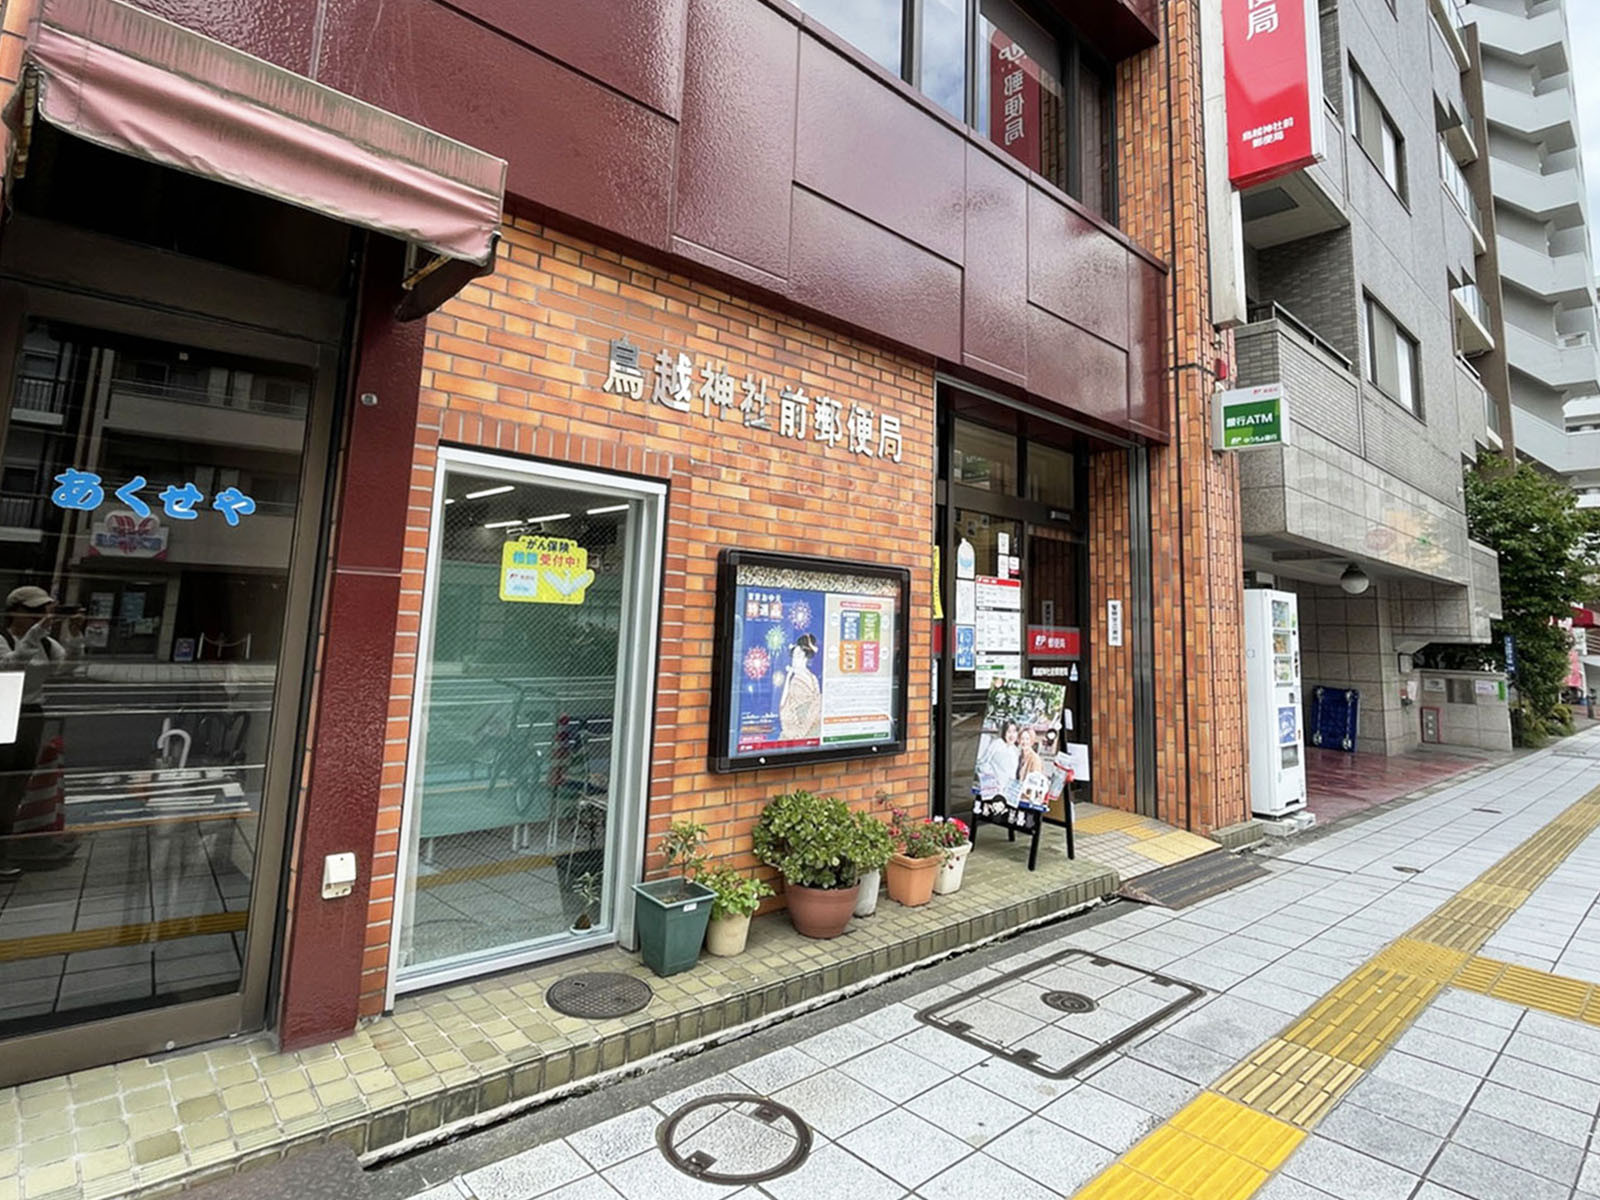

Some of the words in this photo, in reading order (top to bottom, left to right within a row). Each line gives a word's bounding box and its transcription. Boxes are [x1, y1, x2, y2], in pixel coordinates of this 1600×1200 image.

[1247, 0, 1279, 41] 局
[602, 337, 903, 463] 鳥越神社前郵便局
[51, 468, 256, 526] あくせや
[526, 540, 569, 553] がん保険
